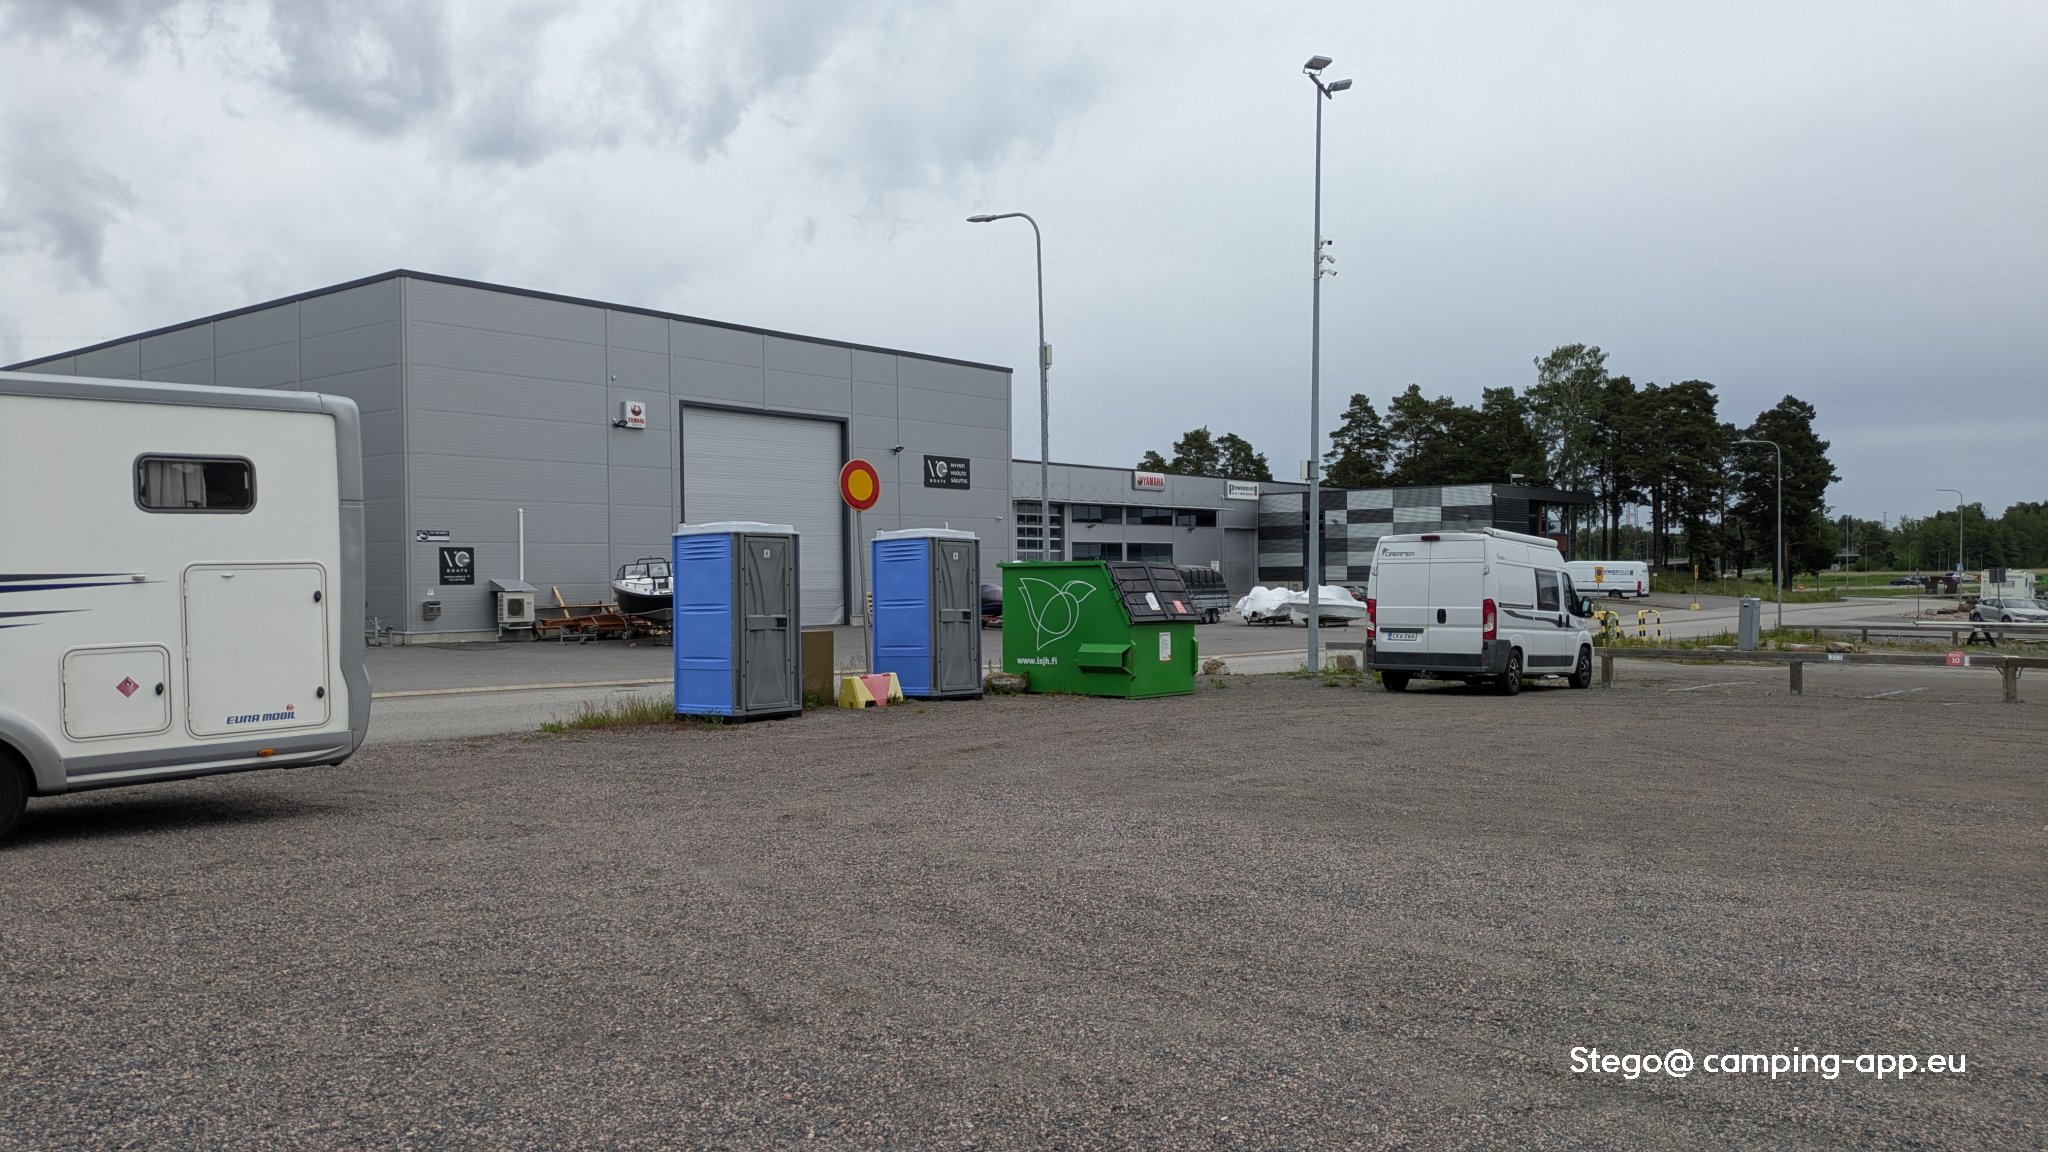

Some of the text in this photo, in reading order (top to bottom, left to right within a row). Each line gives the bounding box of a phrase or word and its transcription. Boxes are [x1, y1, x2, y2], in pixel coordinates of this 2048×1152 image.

[1143, 476, 1164, 487] YAMAHA
[1016, 656, 1058, 667] www.lsjh.fi
[226, 711, 296, 724] EURA MOBIL
